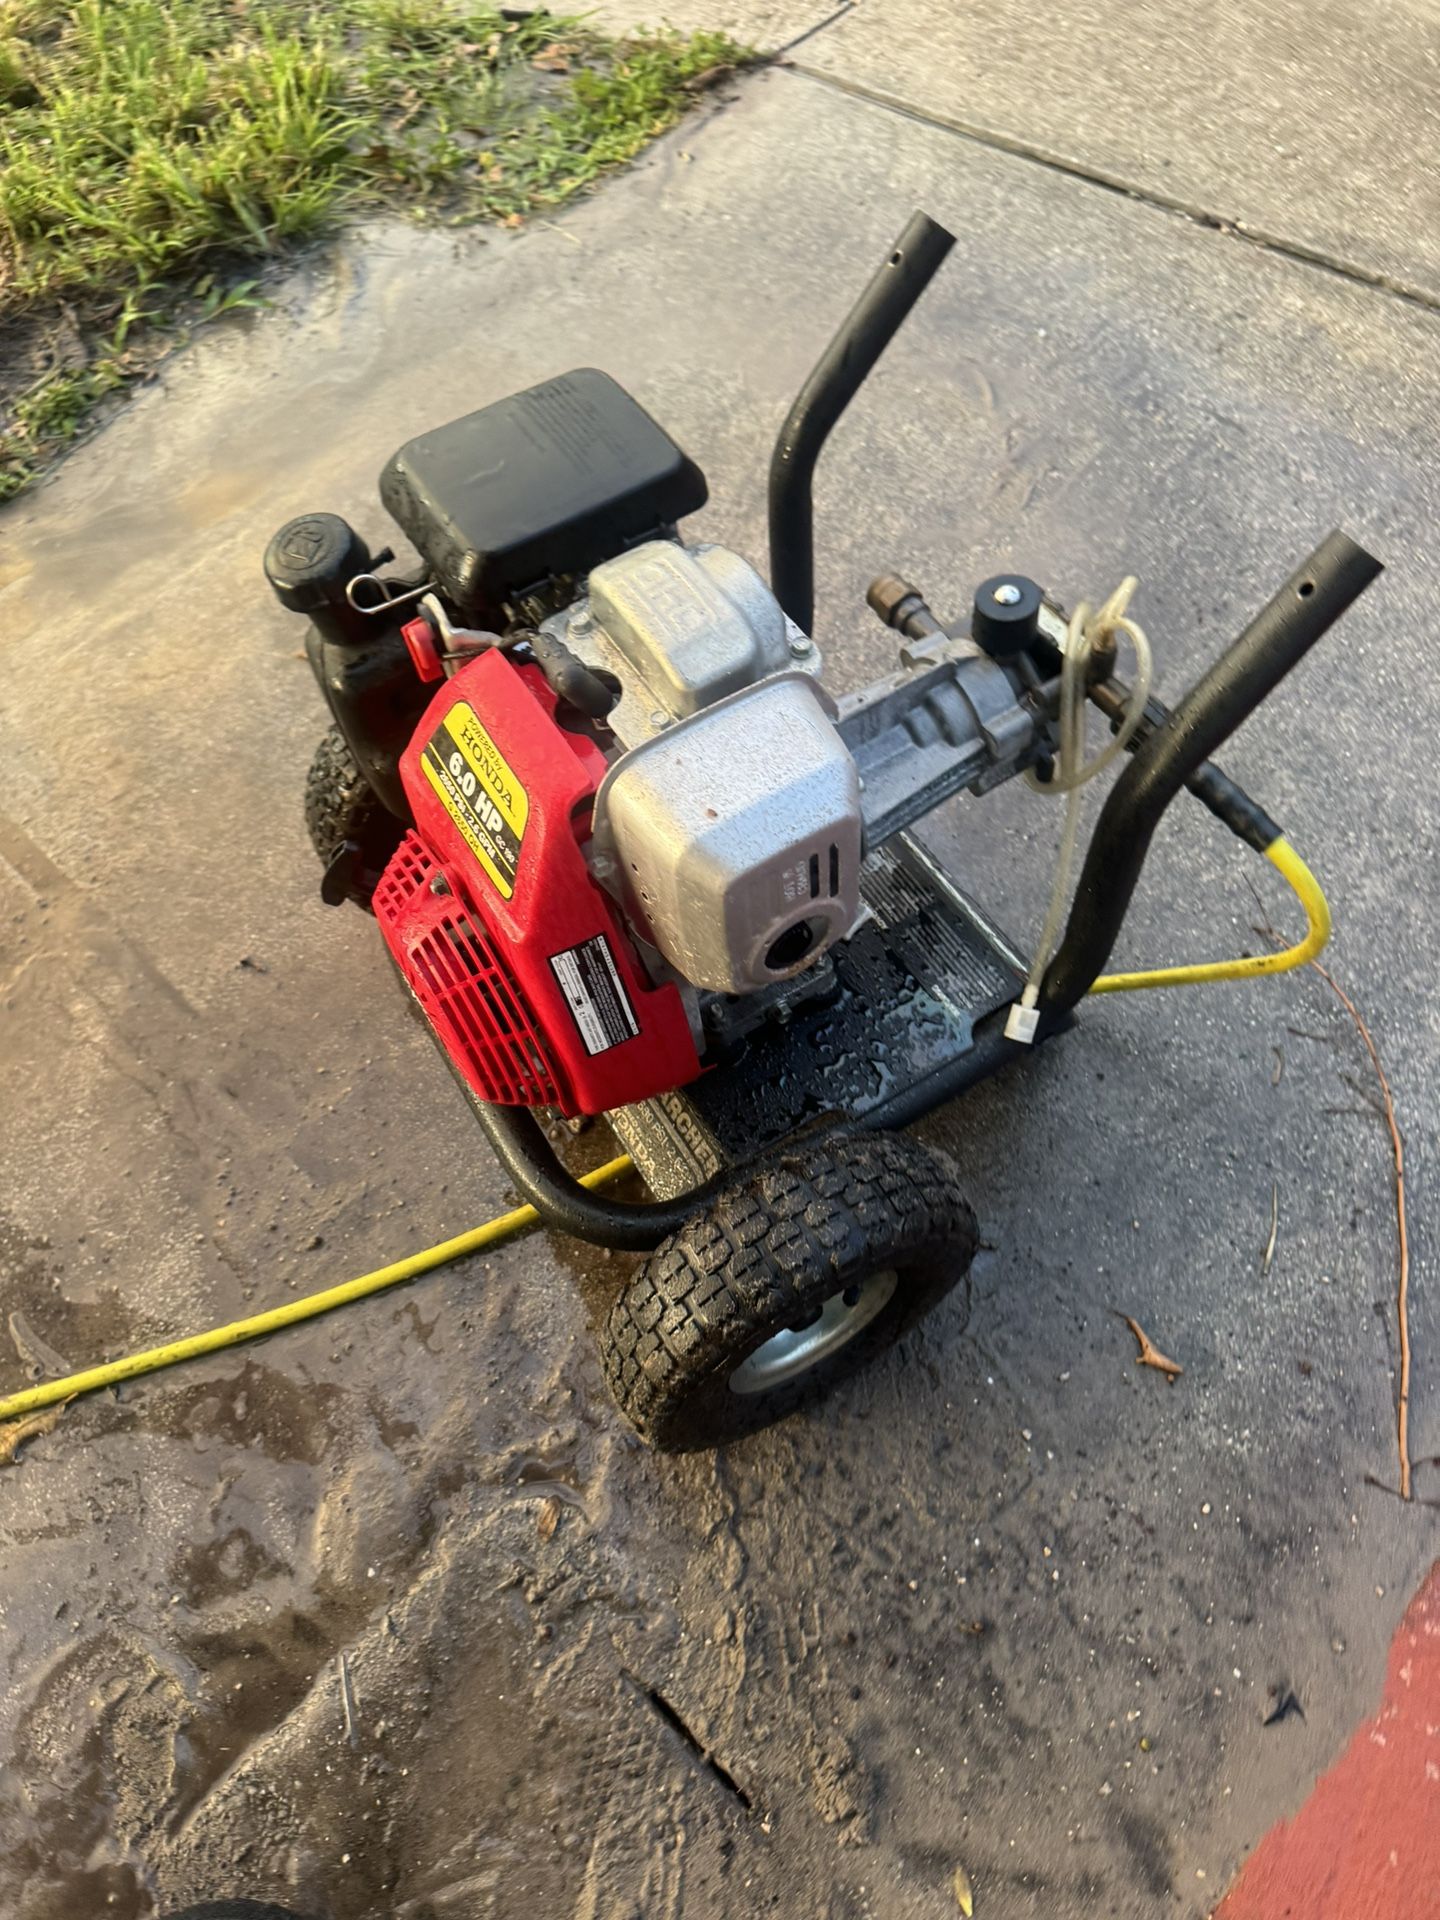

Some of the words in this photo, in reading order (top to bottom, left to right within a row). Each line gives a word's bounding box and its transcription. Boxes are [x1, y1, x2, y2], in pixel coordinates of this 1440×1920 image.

[467, 717, 496, 759] POWERED
[460, 724, 513, 813] HONDA
[449, 752, 476, 797] 6.0
[474, 790, 503, 832] HP
[478, 832, 496, 858] GPM
[651, 1122, 668, 1146] PSI
